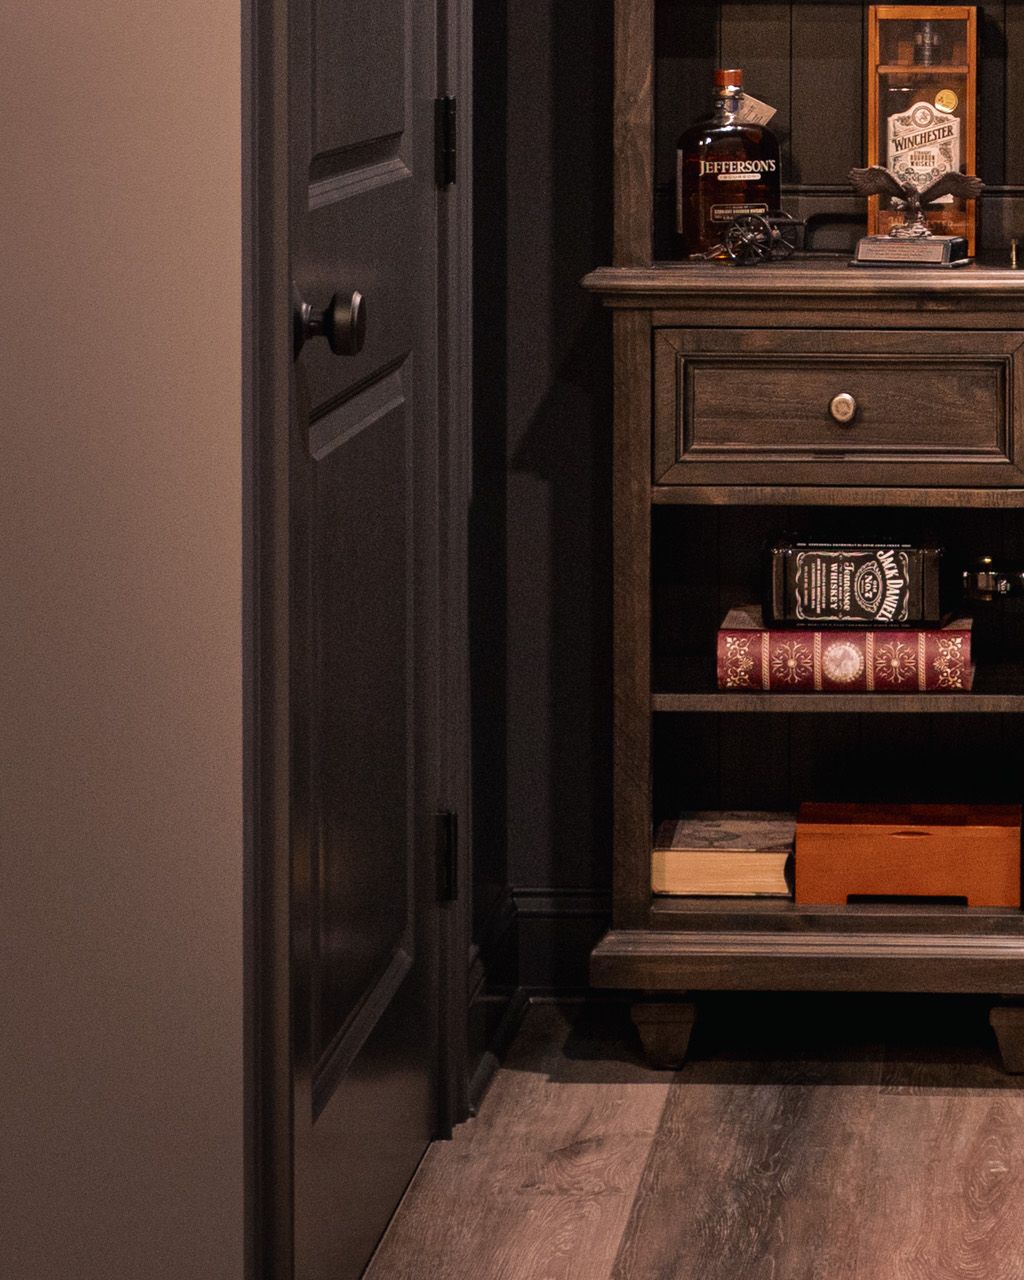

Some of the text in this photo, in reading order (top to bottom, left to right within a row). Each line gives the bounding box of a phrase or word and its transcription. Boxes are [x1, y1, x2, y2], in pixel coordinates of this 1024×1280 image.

[892, 125, 954, 152] WINCHESTER
[699, 160, 776, 177] JEFFERSON'S
[830, 563, 838, 610] WHISKEY
[843, 562, 855, 611] Tennessee
[864, 574, 873, 599] No.7
[875, 549, 904, 622] JACK DANIEL'S
